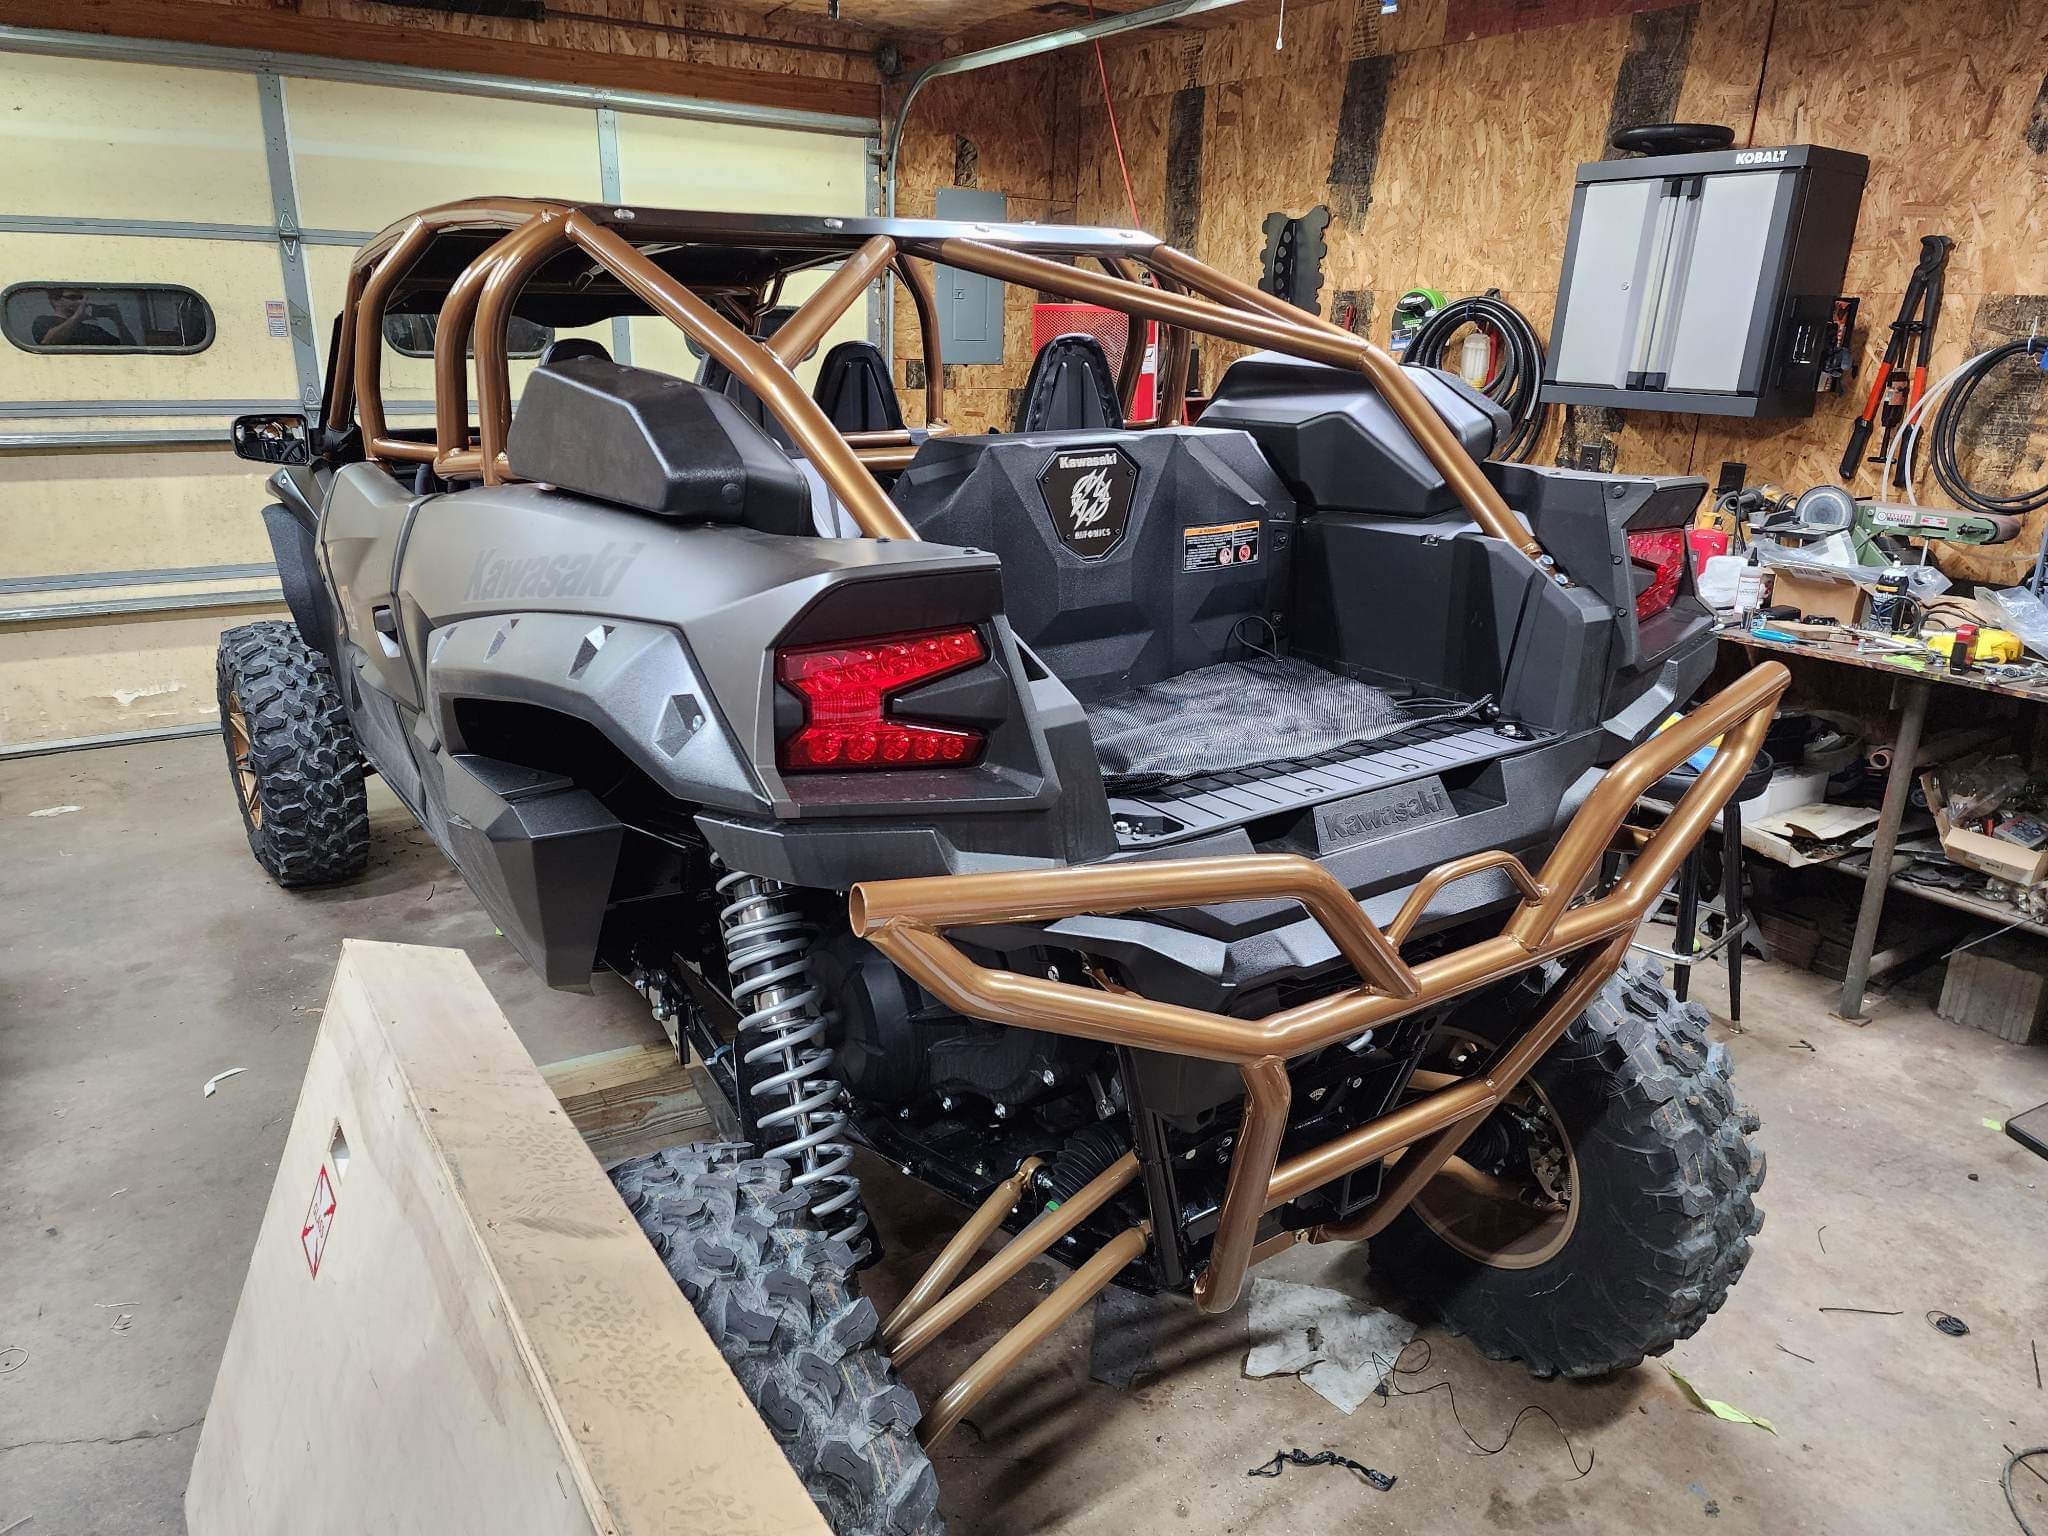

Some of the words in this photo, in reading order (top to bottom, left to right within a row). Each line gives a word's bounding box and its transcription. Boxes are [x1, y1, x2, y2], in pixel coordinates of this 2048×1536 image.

[1736, 150, 1787, 165] KOBALT
[1059, 453, 1117, 469] Kawasaki
[464, 542, 648, 601] Kawasaki
[1323, 787, 1444, 841] Kawasaki
